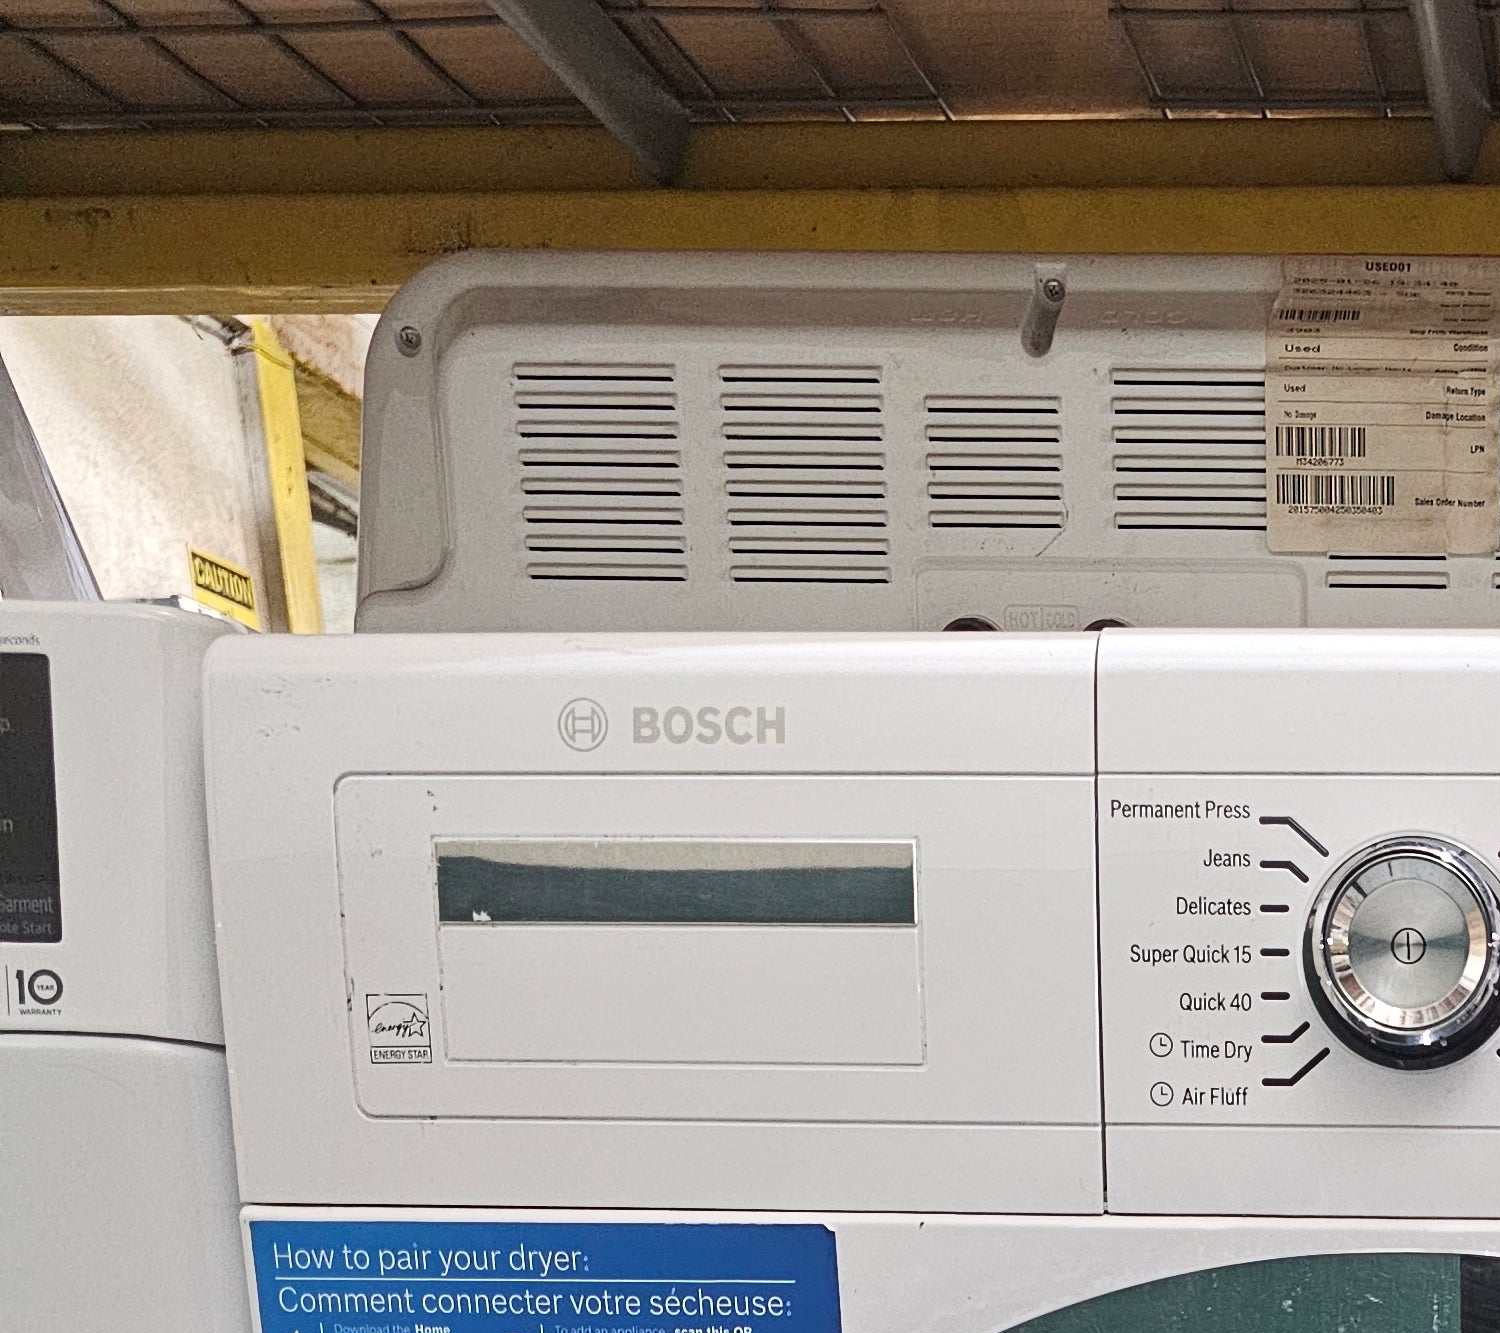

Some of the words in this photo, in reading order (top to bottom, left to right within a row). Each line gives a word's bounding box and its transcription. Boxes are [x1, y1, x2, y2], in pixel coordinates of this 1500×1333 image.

[1366, 262, 1412, 273] USED01
[1284, 343, 1321, 354] Used
[1454, 343, 1488, 353] Condition
[1284, 384, 1306, 393] Used
[1446, 386, 1469, 396] Return
[1471, 387, 1486, 397] Type
[1426, 411, 1454, 421] Damage
[1456, 412, 1486, 422] Location
[1470, 445, 1485, 454] LPN
[1415, 497, 1434, 506] Sales
[1436, 498, 1456, 507] Order
[1458, 499, 1486, 508] Number
[193, 556, 253, 607] CAUTION
[632, 706, 786, 745] BOSCH
[1110, 799, 1201, 819] Permanent
[1205, 801, 1251, 819] Press
[1203, 849, 1251, 868] Jeans
[1176, 896, 1251, 916] Delicates
[1130, 945, 1178, 967] Super
[1183, 944, 1230, 964] Quick
[1234, 946, 1252, 963] 15
[15, 969, 64, 1005] 10
[1180, 992, 1226, 1011] Quick
[1230, 993, 1252, 1011] 40
[18, 1008, 63, 1016] WARRANTY
[373, 1049, 406, 1060] ENERGY
[407, 1049, 429, 1060] STAR
[1180, 1040, 1220, 1059] Time
[1224, 1041, 1253, 1063] Dry
[1182, 1087, 1206, 1106] Air
[1210, 1087, 1249, 1106] Fluff
[274, 1242, 335, 1270] How
[342, 1243, 370, 1270] to
[379, 1242, 432, 1276] pair
[439, 1249, 501, 1277] your
[509, 1243, 589, 1278] dryer:
[278, 1286, 416, 1314] Comment
[422, 1288, 563, 1315] connecter
[570, 1290, 641, 1315] votre
[650, 1287, 792, 1316] sécheuse:
